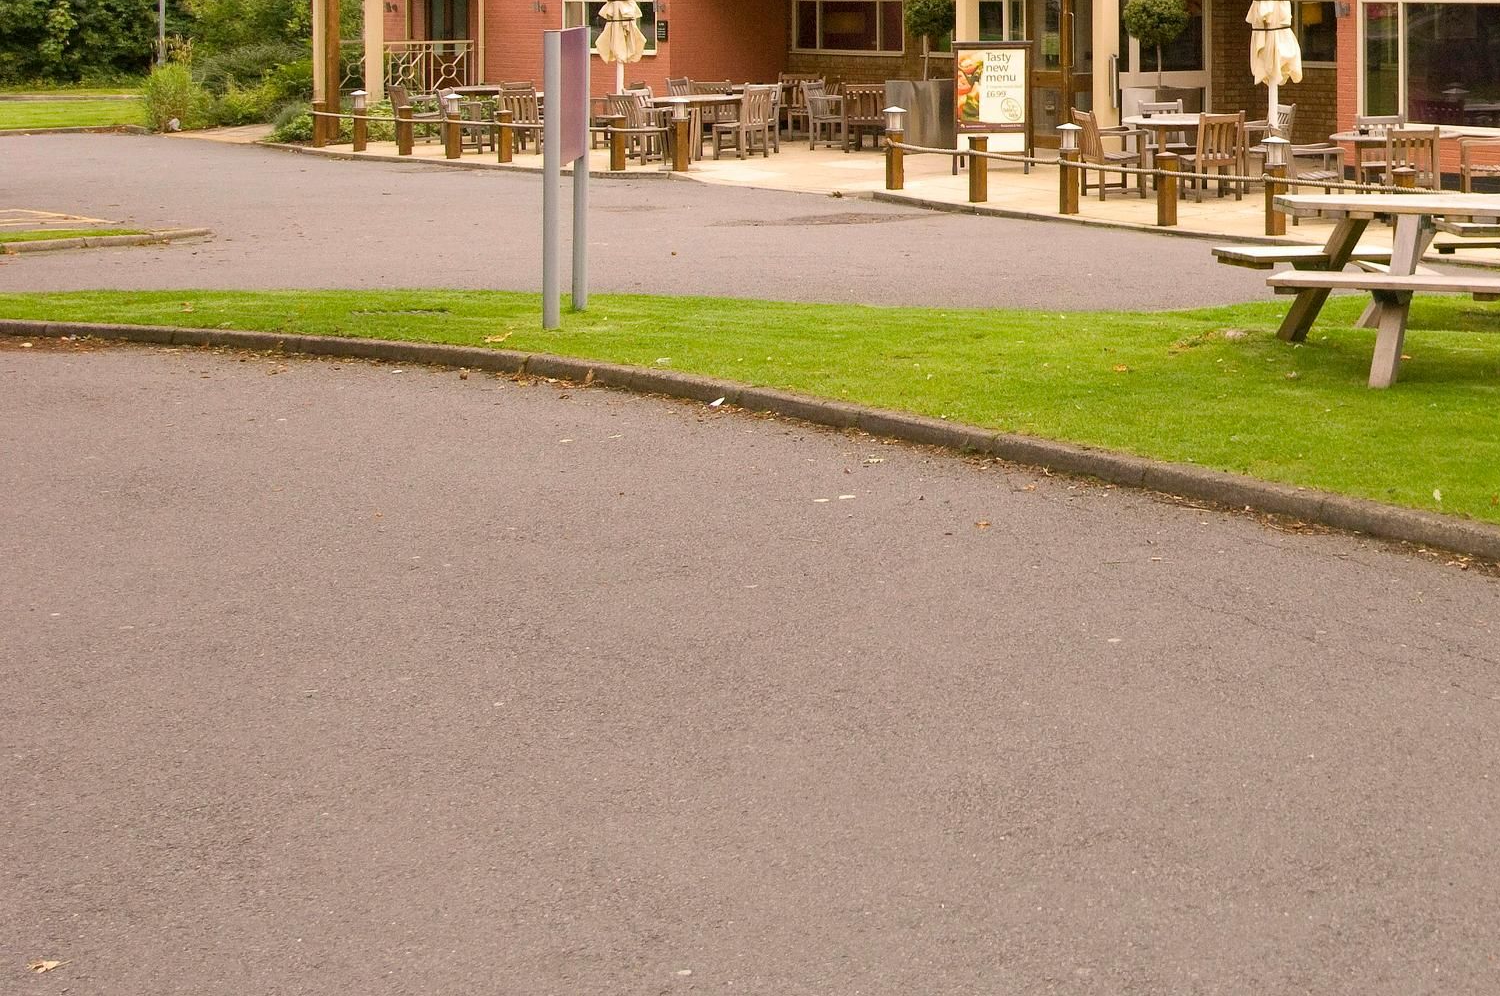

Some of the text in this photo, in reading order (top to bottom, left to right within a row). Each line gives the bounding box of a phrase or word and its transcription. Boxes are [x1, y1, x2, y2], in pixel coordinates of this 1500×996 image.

[986, 52, 1011, 64] Tasty
[986, 64, 1009, 72] new
[986, 74, 1017, 82] menu
